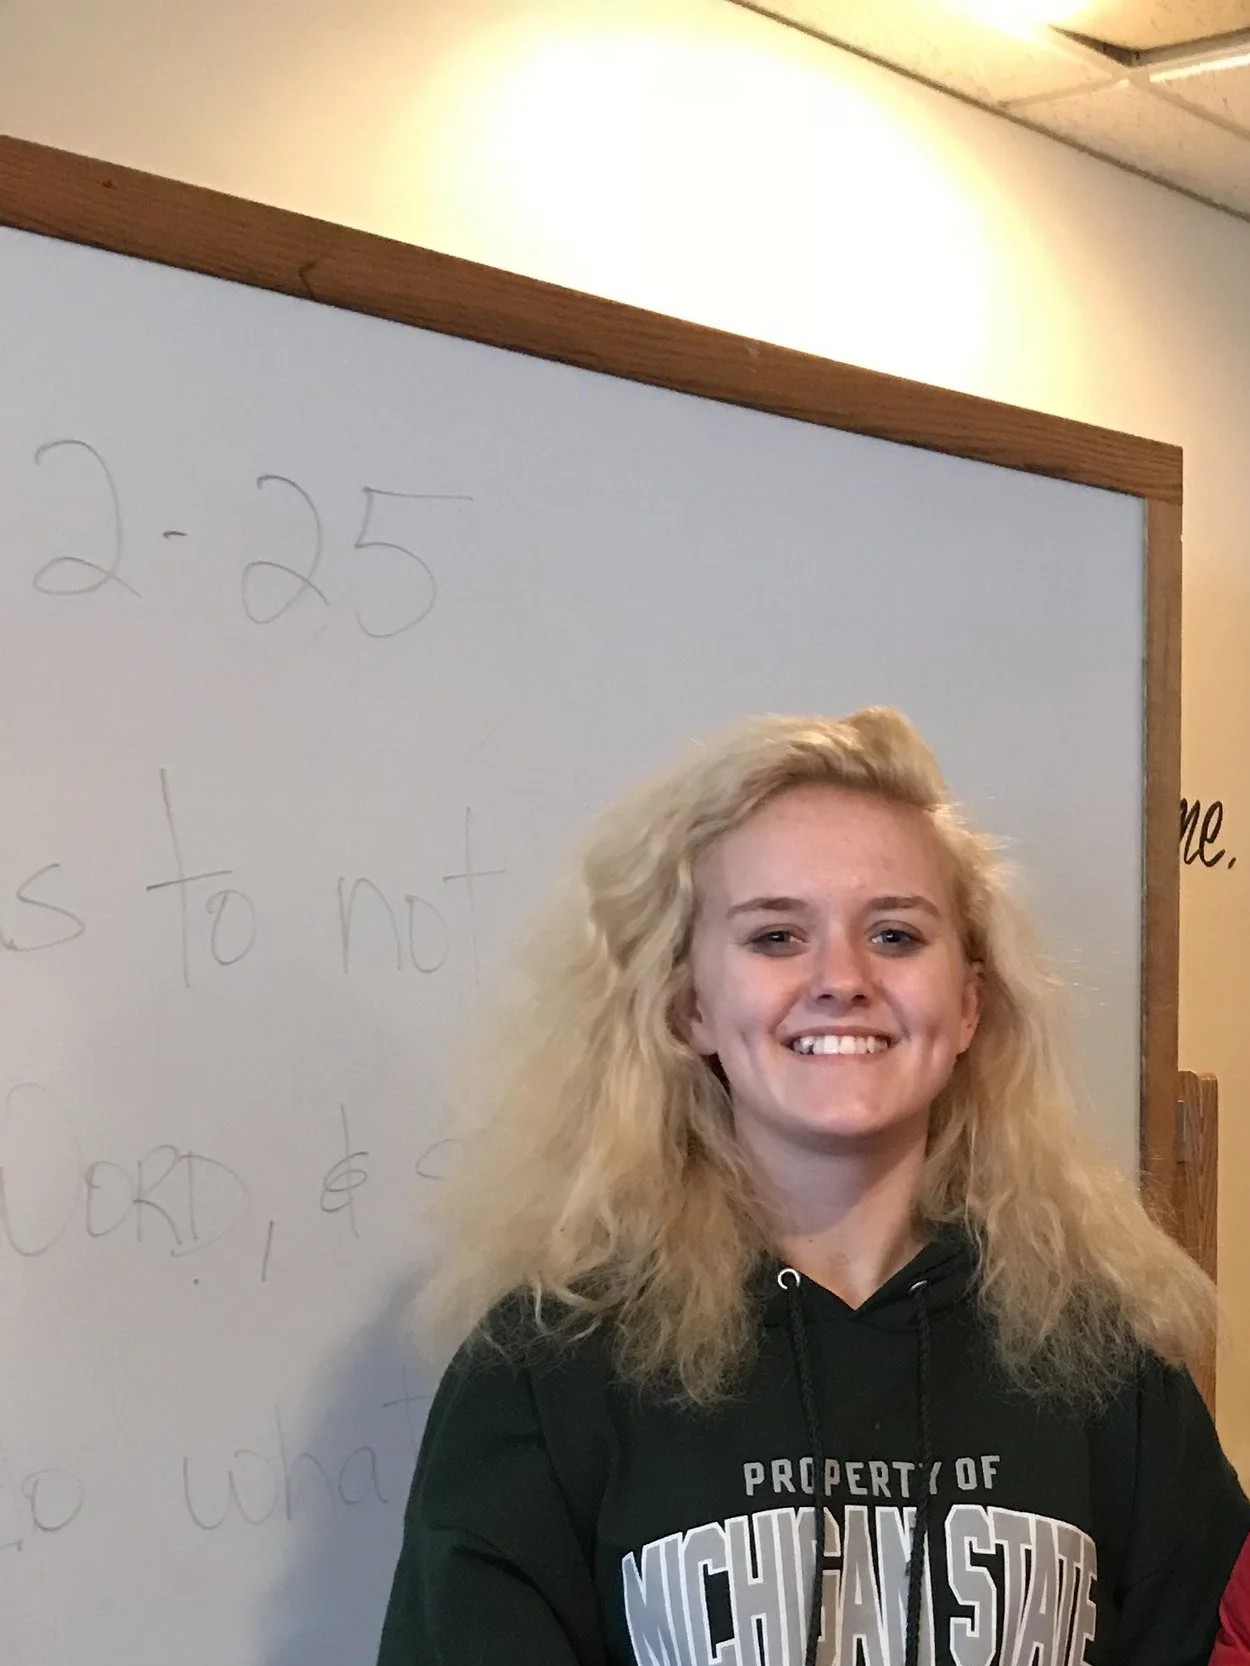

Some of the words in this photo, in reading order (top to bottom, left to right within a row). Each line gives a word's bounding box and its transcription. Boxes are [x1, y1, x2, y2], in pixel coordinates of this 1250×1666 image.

[146, 768, 257, 988] to
[337, 806, 506, 988] not
[743, 1456, 943, 1498] PROPERTY
[955, 1455, 1001, 1491] OF
